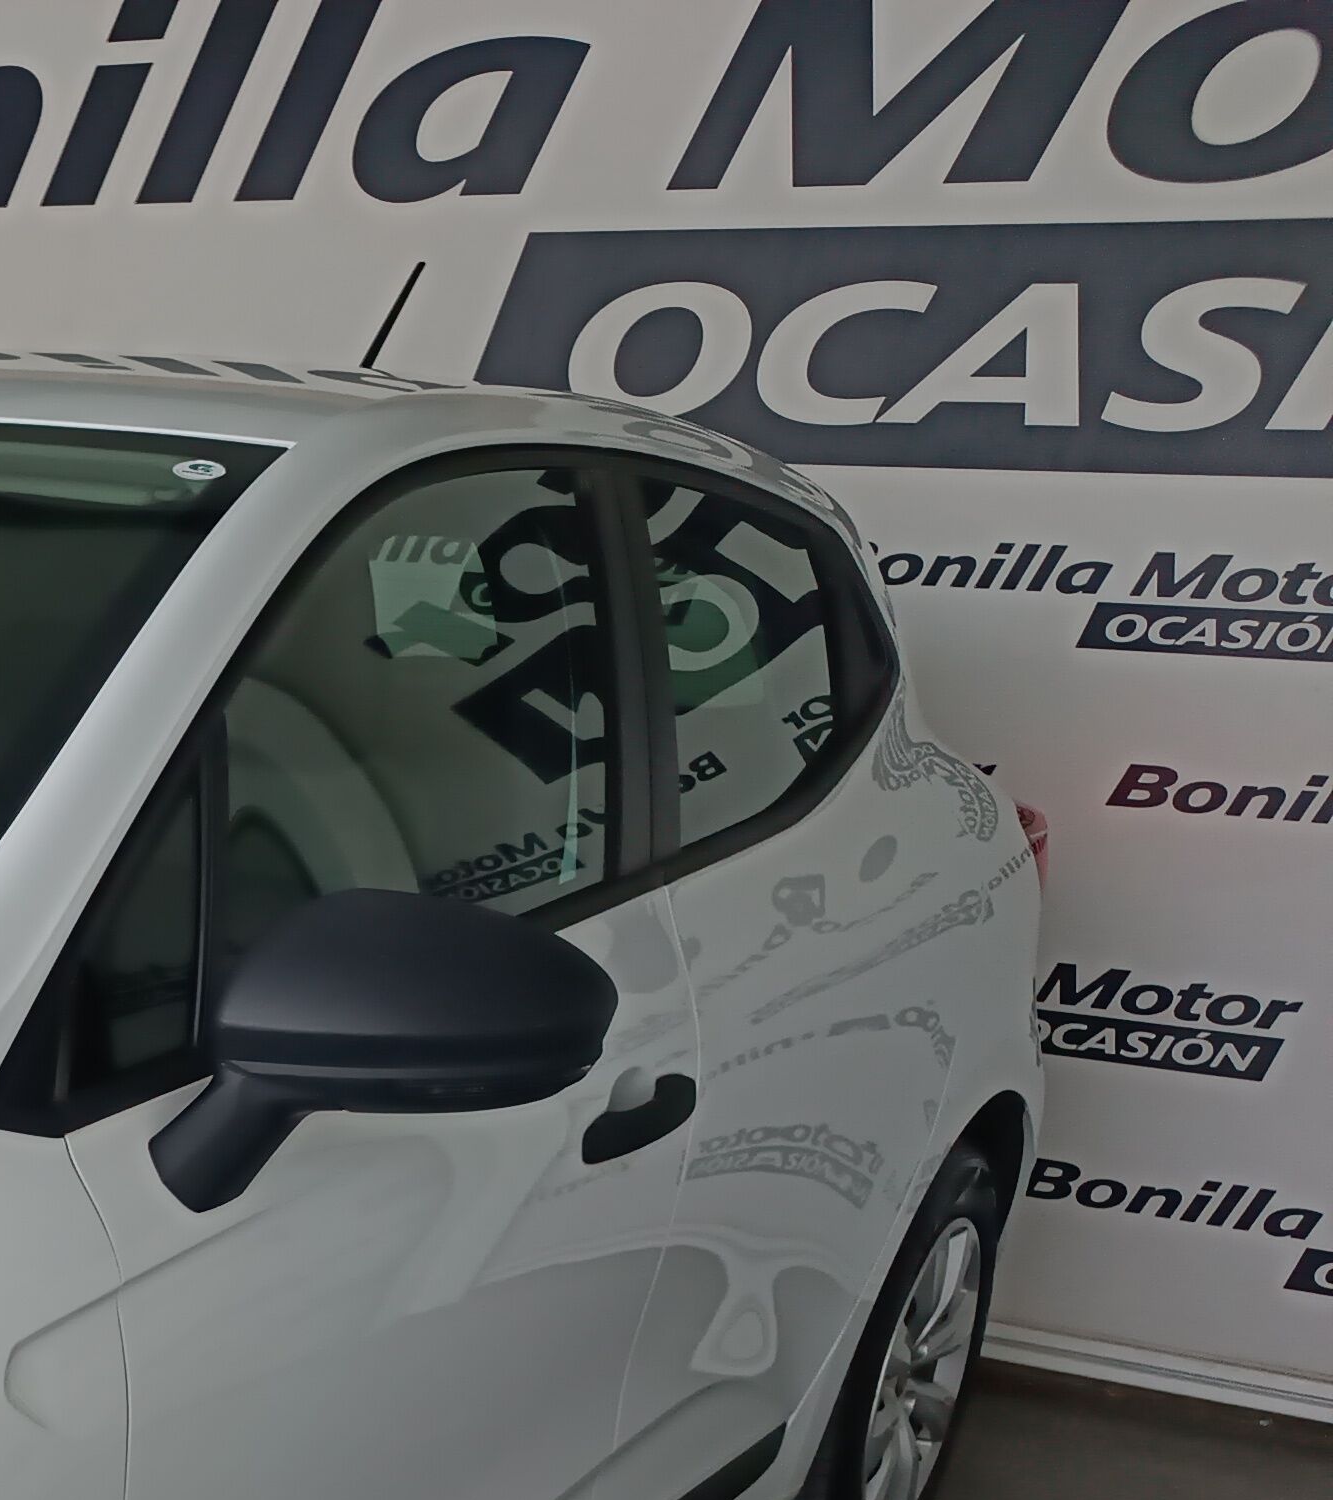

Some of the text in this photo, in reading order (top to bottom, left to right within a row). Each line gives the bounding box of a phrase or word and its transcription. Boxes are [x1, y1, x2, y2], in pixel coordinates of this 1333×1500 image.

[869, 541, 1113, 594] onilla
[1037, 962, 1303, 1030] Motor
[1026, 1158, 1323, 1240] Bonilla
